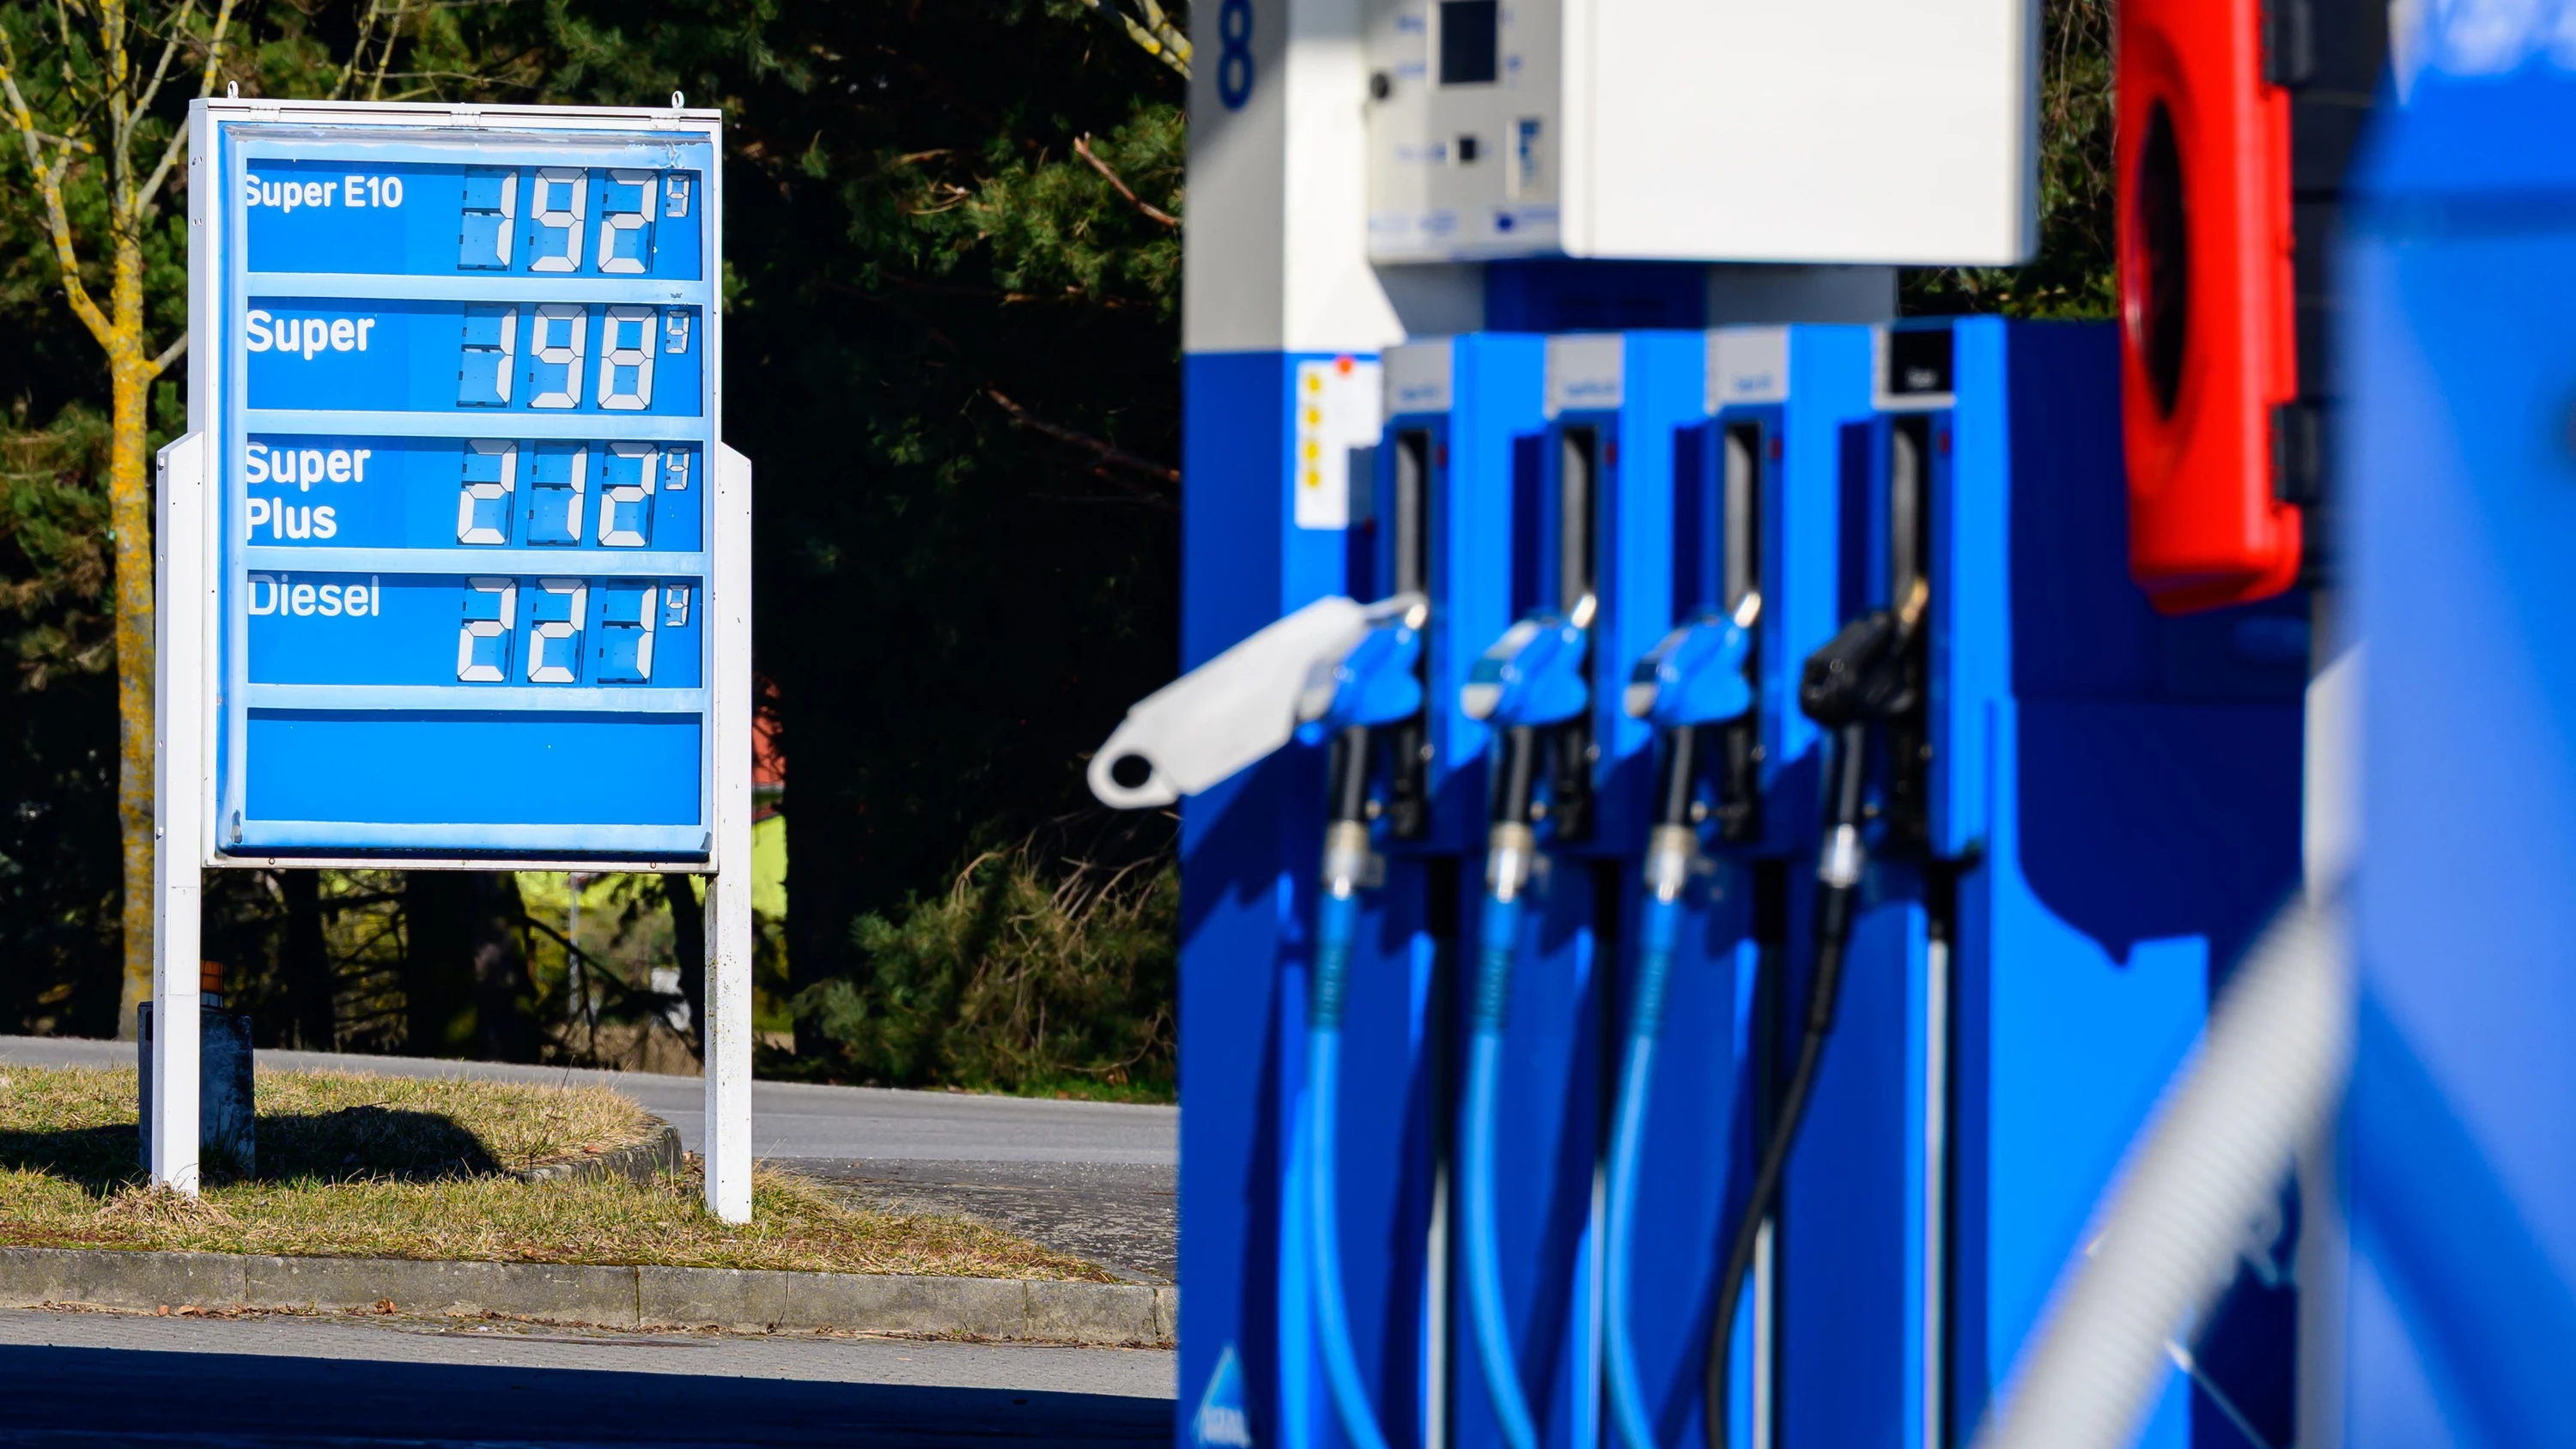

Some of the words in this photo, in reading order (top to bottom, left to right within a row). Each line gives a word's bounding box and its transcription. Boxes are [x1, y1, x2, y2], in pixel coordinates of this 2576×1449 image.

[1218, 0, 1255, 112] 8
[246, 174, 337, 214] Super
[344, 175, 403, 208] E10
[246, 309, 375, 361] Super
[246, 442, 372, 492] Super
[246, 497, 337, 540] Plus
[247, 573, 380, 617] Diesel
